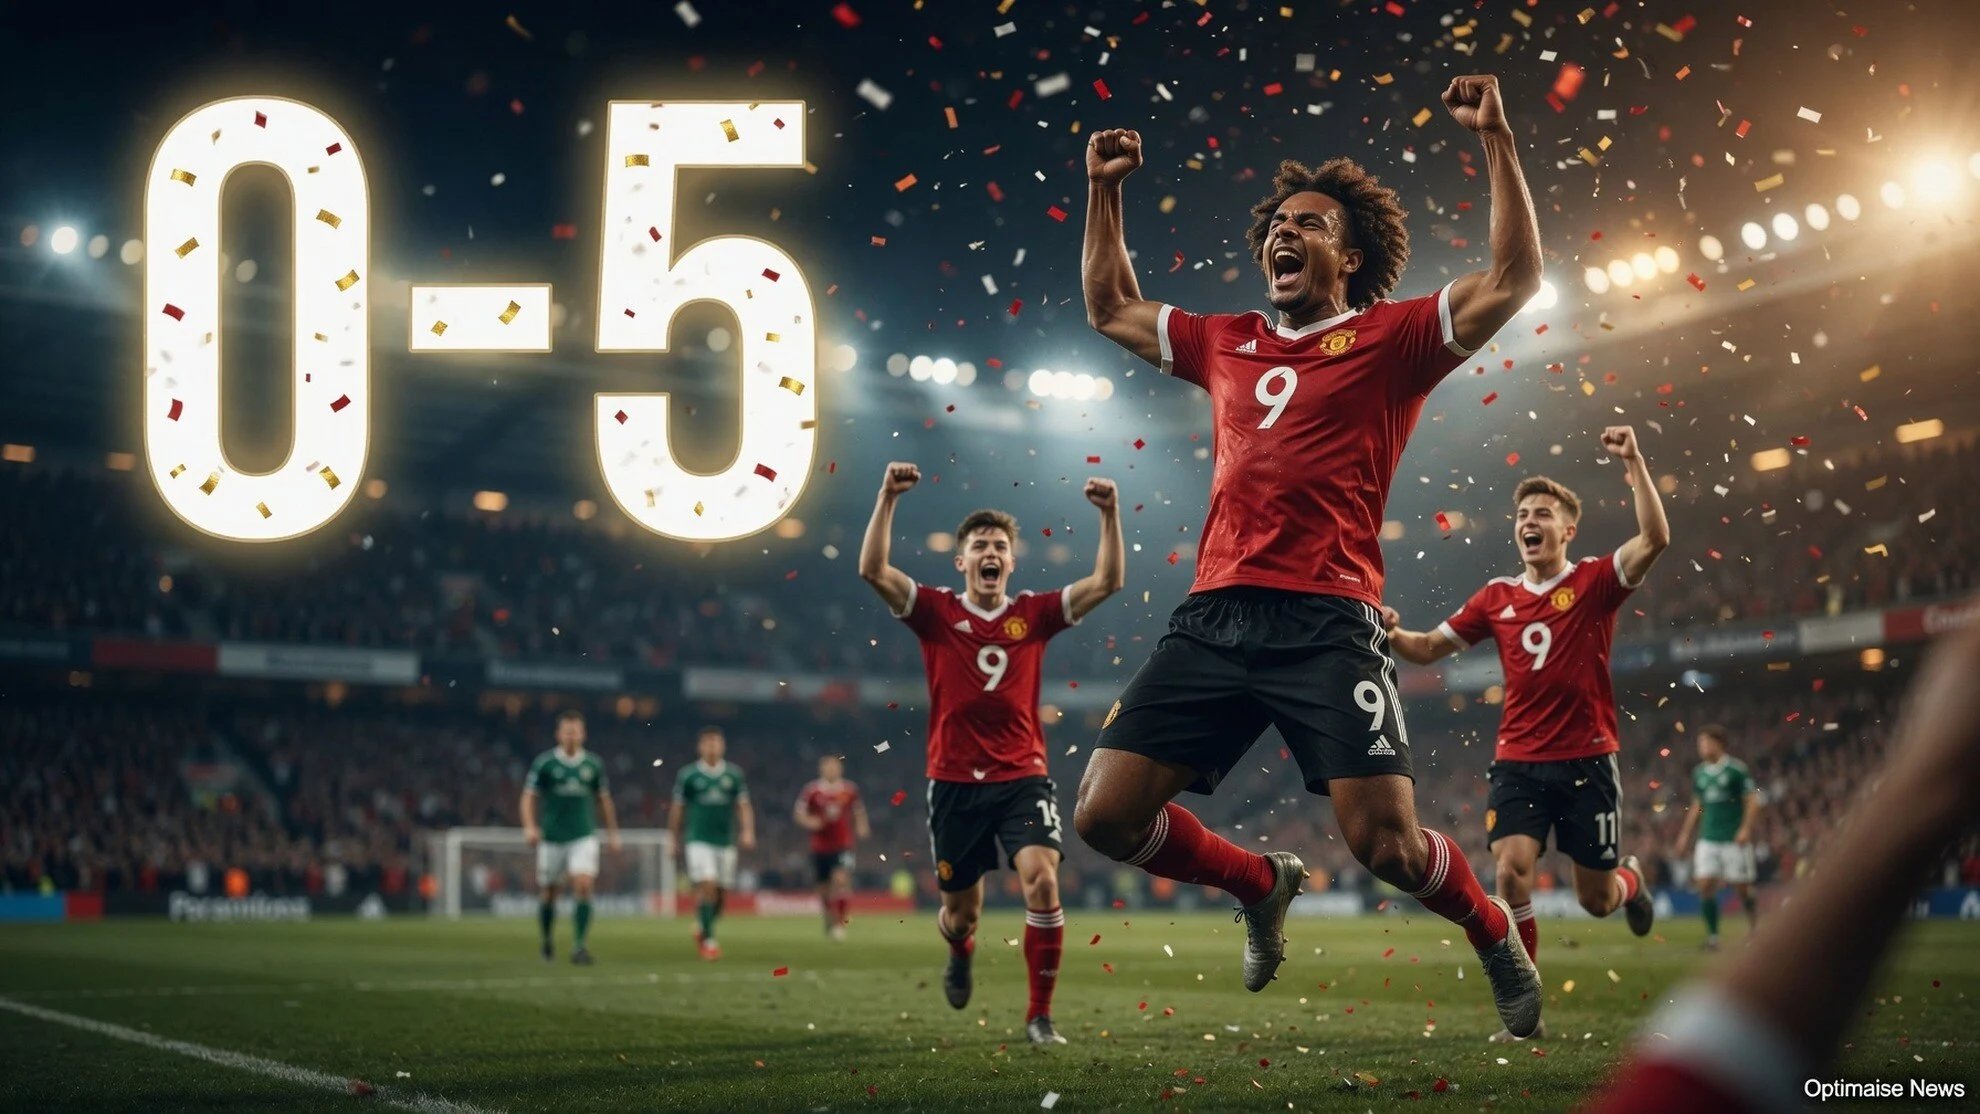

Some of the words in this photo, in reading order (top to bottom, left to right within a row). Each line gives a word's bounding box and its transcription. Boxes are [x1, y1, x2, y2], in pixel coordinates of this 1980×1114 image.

[1255, 366, 1298, 430] 9
[977, 644, 1009, 691] 9
[1521, 621, 1552, 671] 9
[1353, 680, 1385, 731] 9
[1594, 810, 1616, 846] 11
